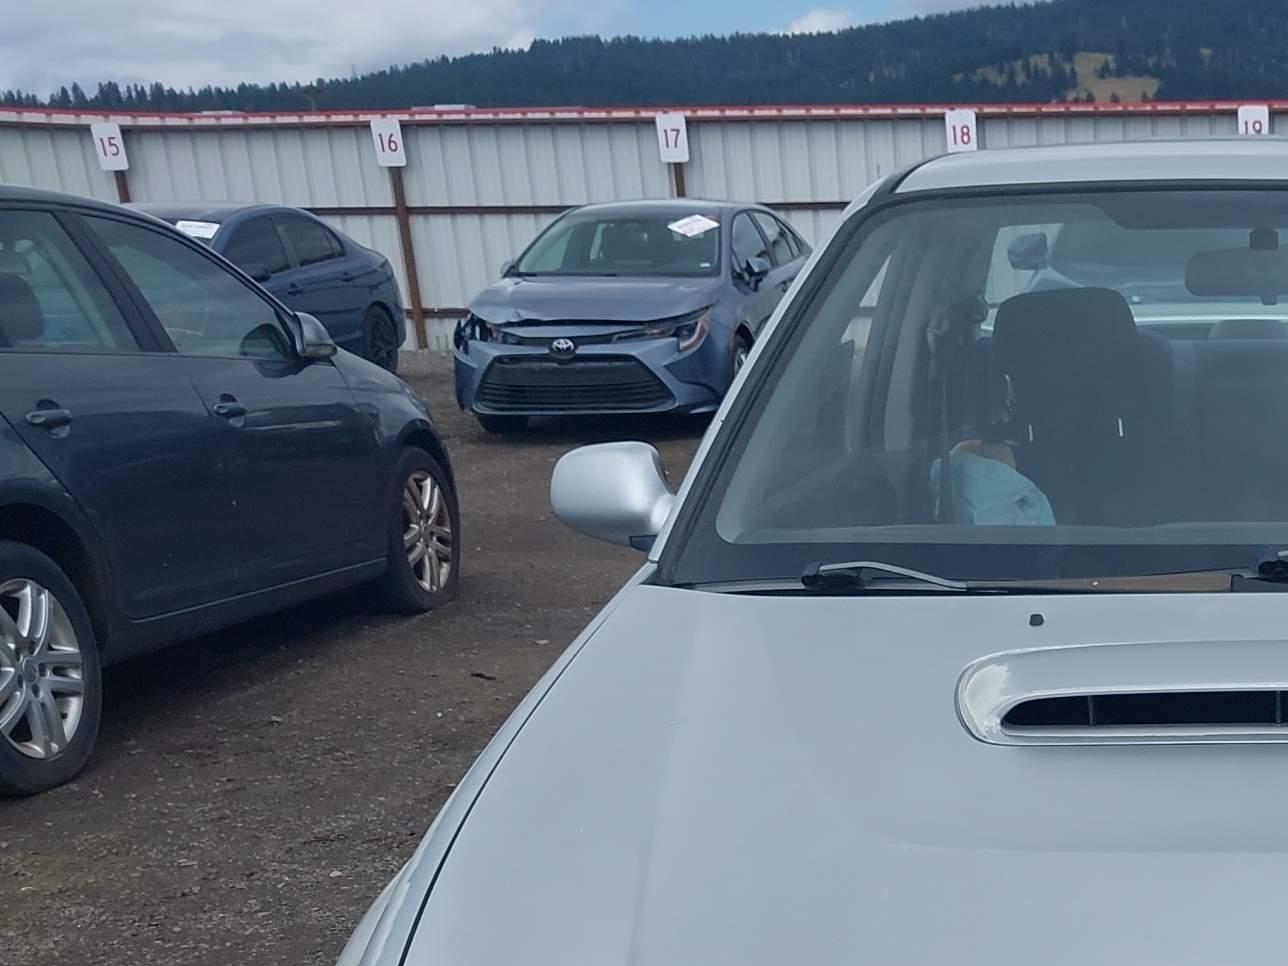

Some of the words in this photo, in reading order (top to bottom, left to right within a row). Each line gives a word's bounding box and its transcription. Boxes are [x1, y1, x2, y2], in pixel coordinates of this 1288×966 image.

[663, 128, 681, 149] 17
[952, 124, 970, 145] 18
[1244, 120, 1263, 136] 19
[100, 136, 120, 157] 15
[378, 133, 398, 153] 16
